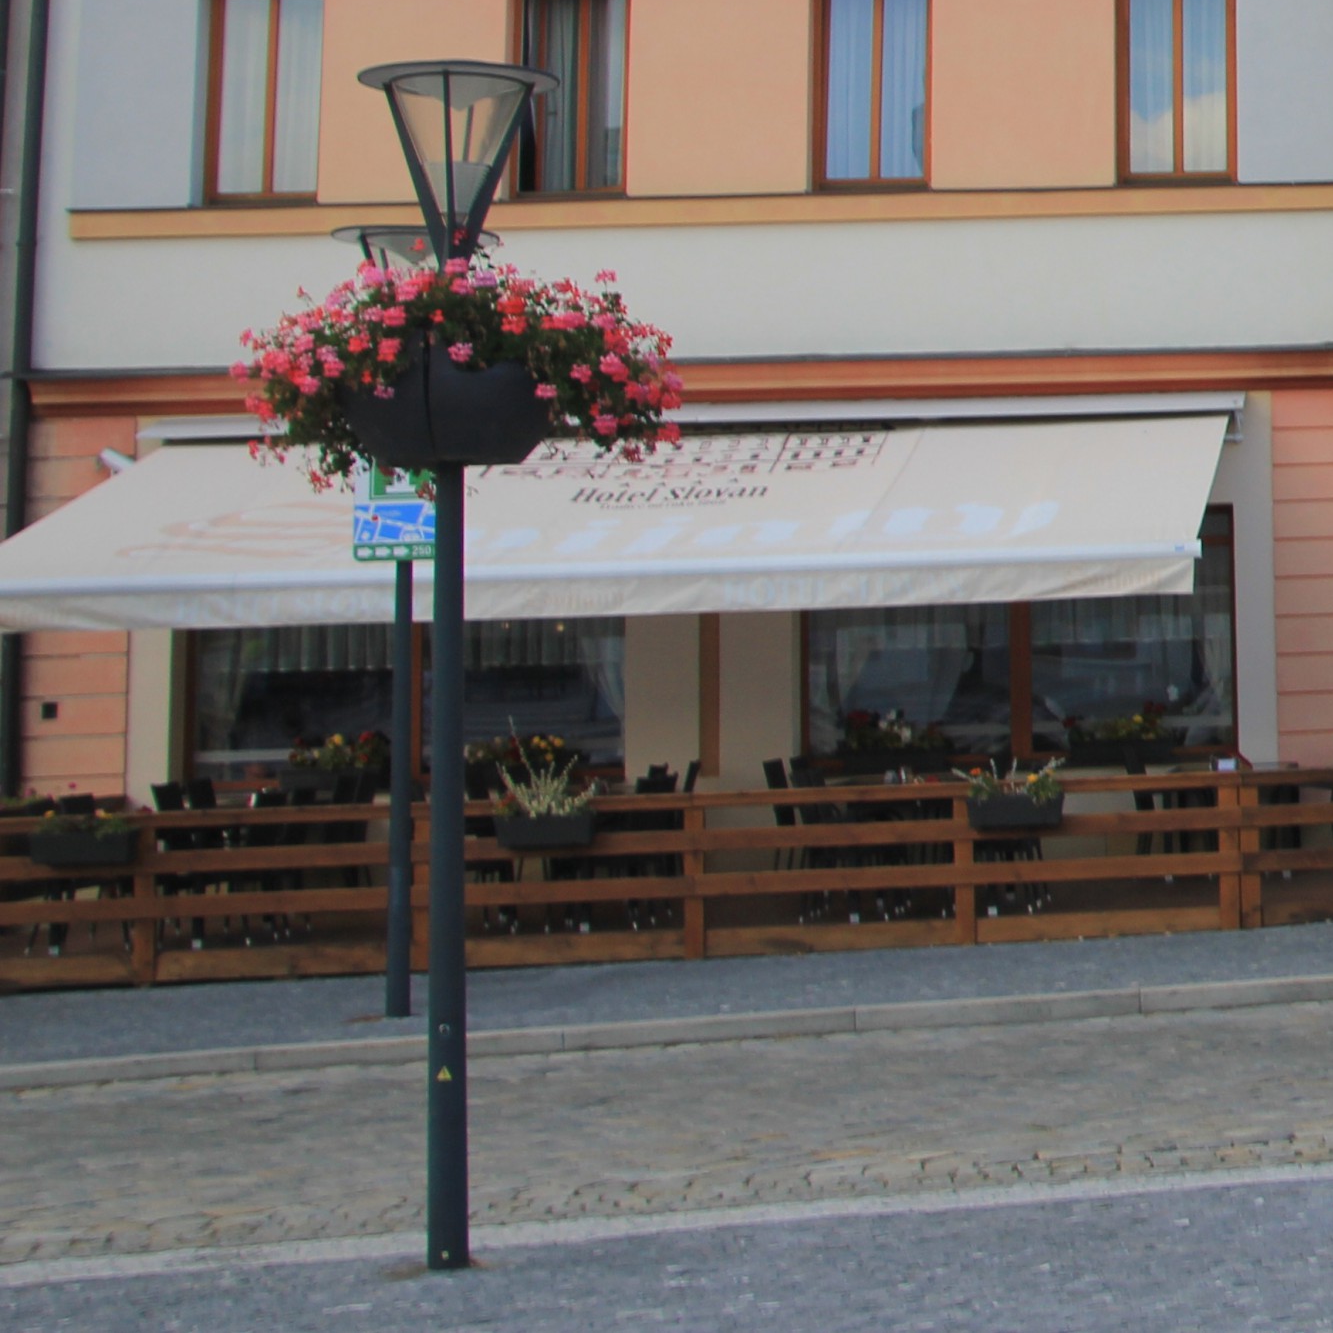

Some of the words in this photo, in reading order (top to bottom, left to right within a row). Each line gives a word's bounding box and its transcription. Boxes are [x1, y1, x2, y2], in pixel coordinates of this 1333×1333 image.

[571, 485, 659, 503] Hotel
[664, 483, 769, 500] Slovan
[411, 545, 432, 556] 250
